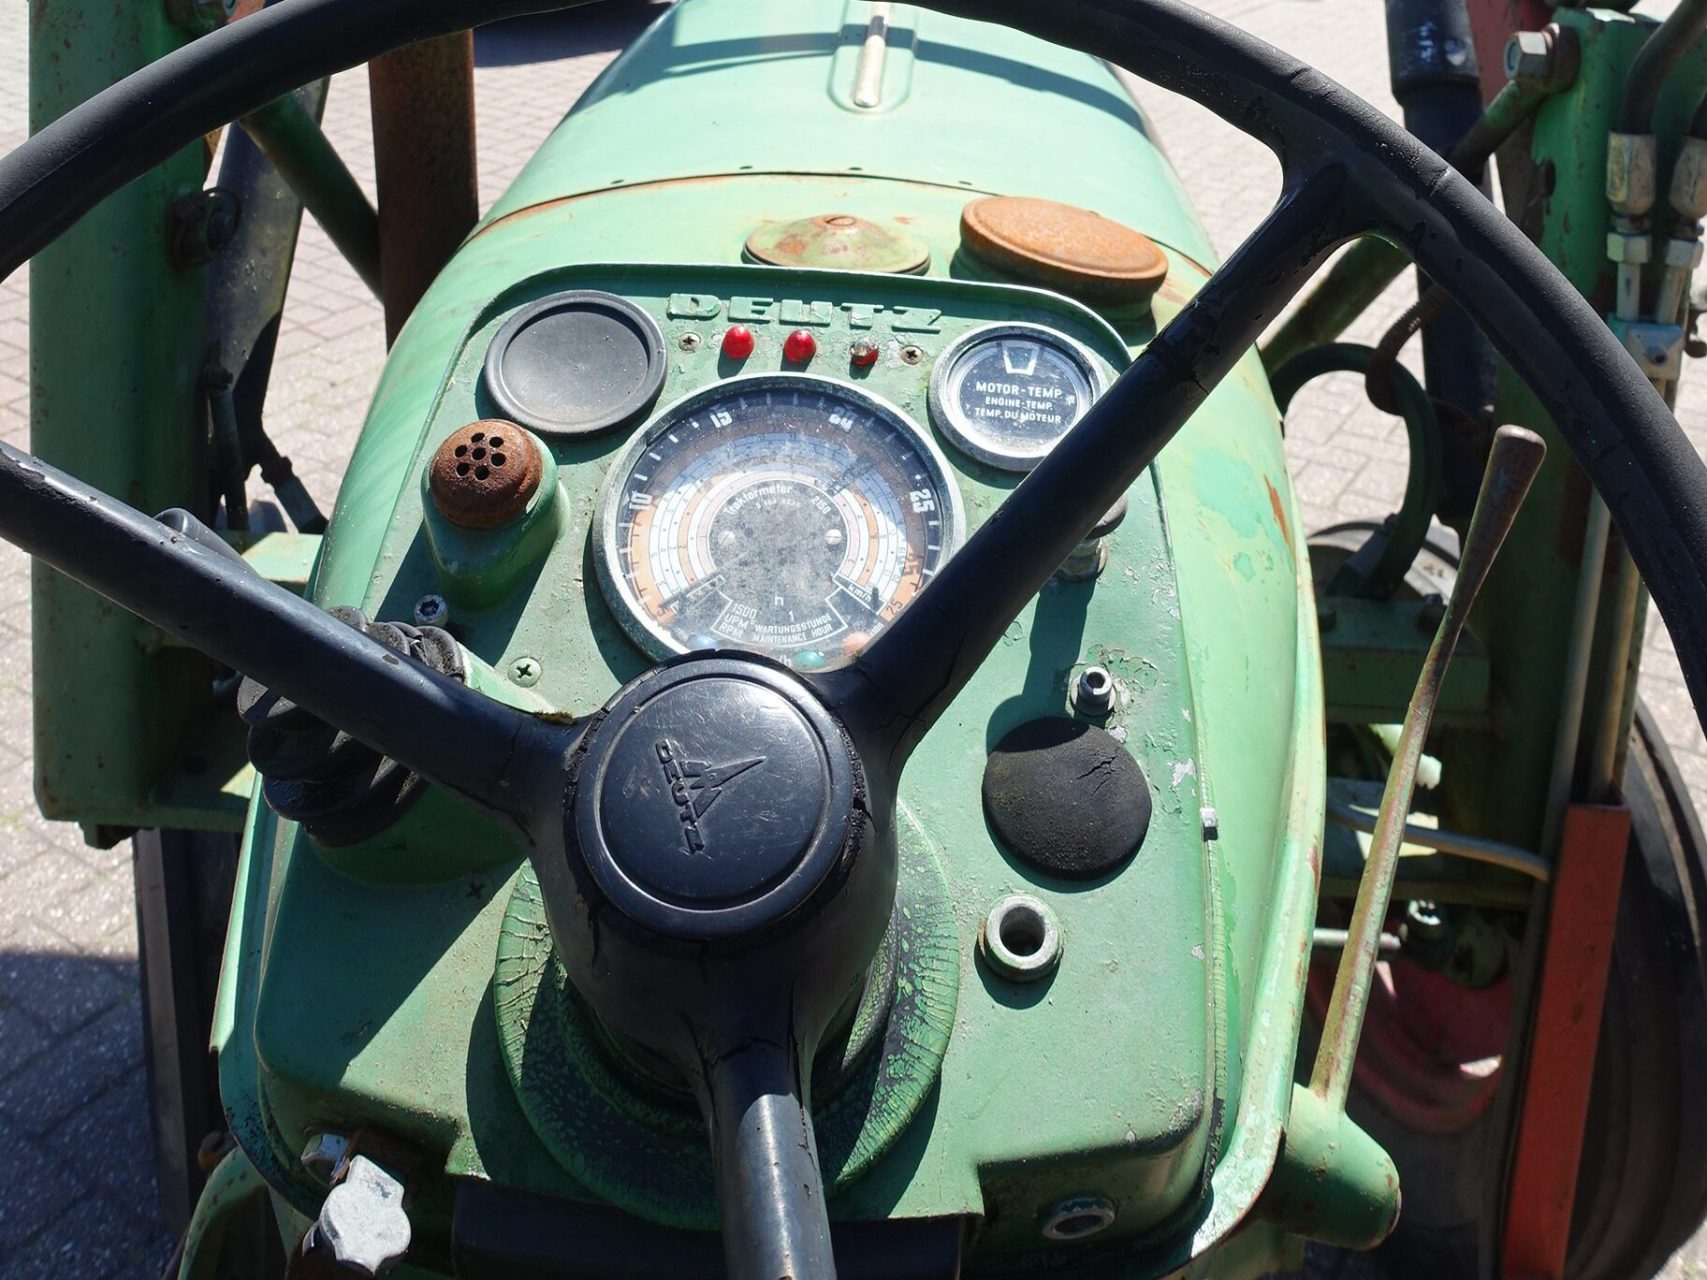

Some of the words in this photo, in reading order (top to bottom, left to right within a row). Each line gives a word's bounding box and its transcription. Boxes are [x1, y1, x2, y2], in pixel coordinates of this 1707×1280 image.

[667, 293, 941, 333] DEUTZ
[709, 407, 732, 428] 15
[1020, 412, 1062, 424] MOTEUR
[629, 491, 652, 510] 10
[811, 495, 832, 516] 2150
[909, 488, 935, 513] 25
[732, 603, 757, 619] 1500
[719, 622, 743, 639] RPM
[811, 623, 833, 638] HOUR
[655, 739, 705, 855] DEUTZ
